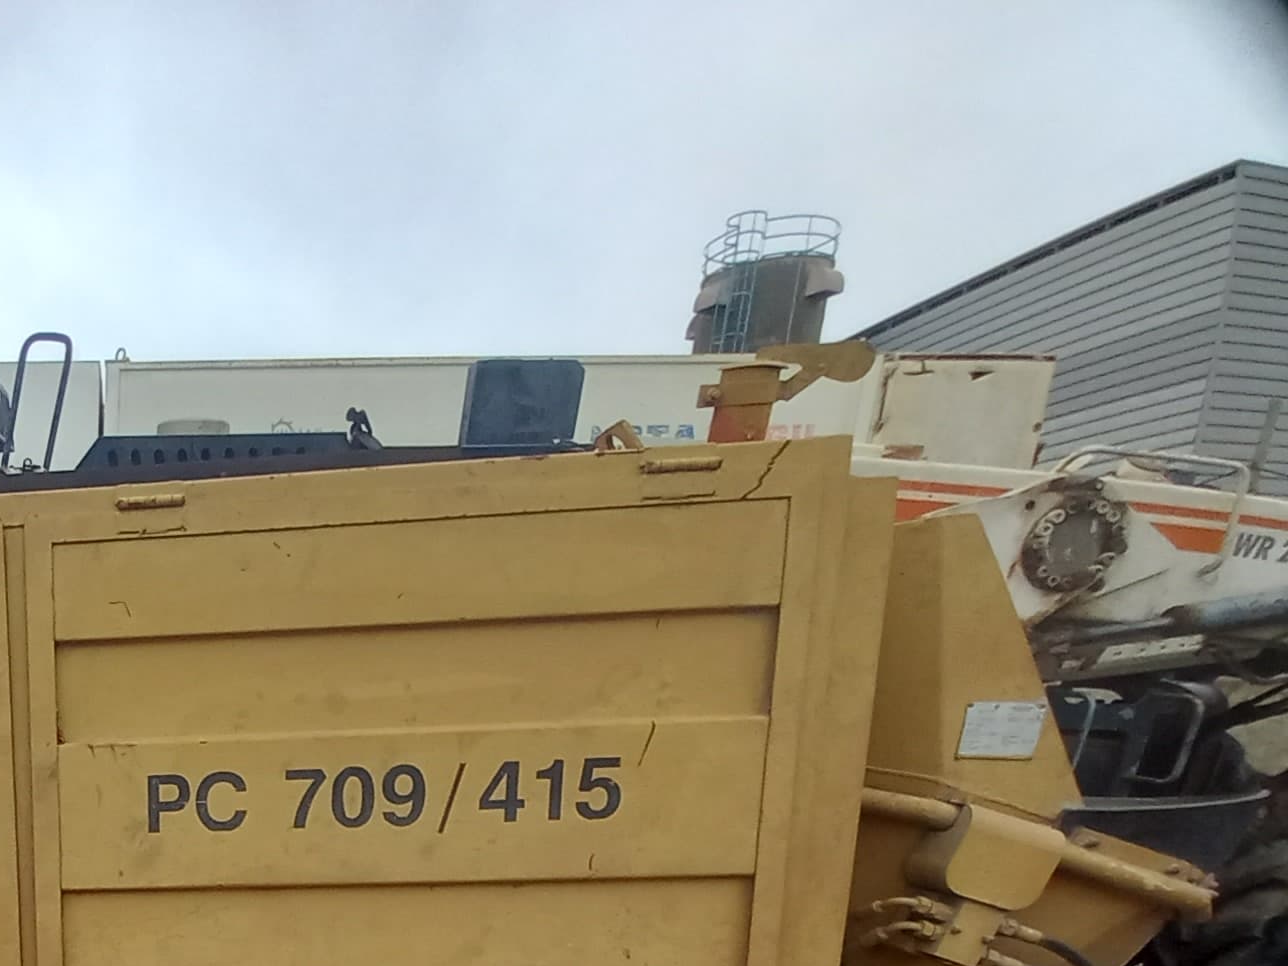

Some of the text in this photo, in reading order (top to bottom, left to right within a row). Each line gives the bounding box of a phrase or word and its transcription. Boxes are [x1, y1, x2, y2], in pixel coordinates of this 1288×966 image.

[1232, 532, 1276, 561] WR
[147, 757, 623, 834] PC 709/415
